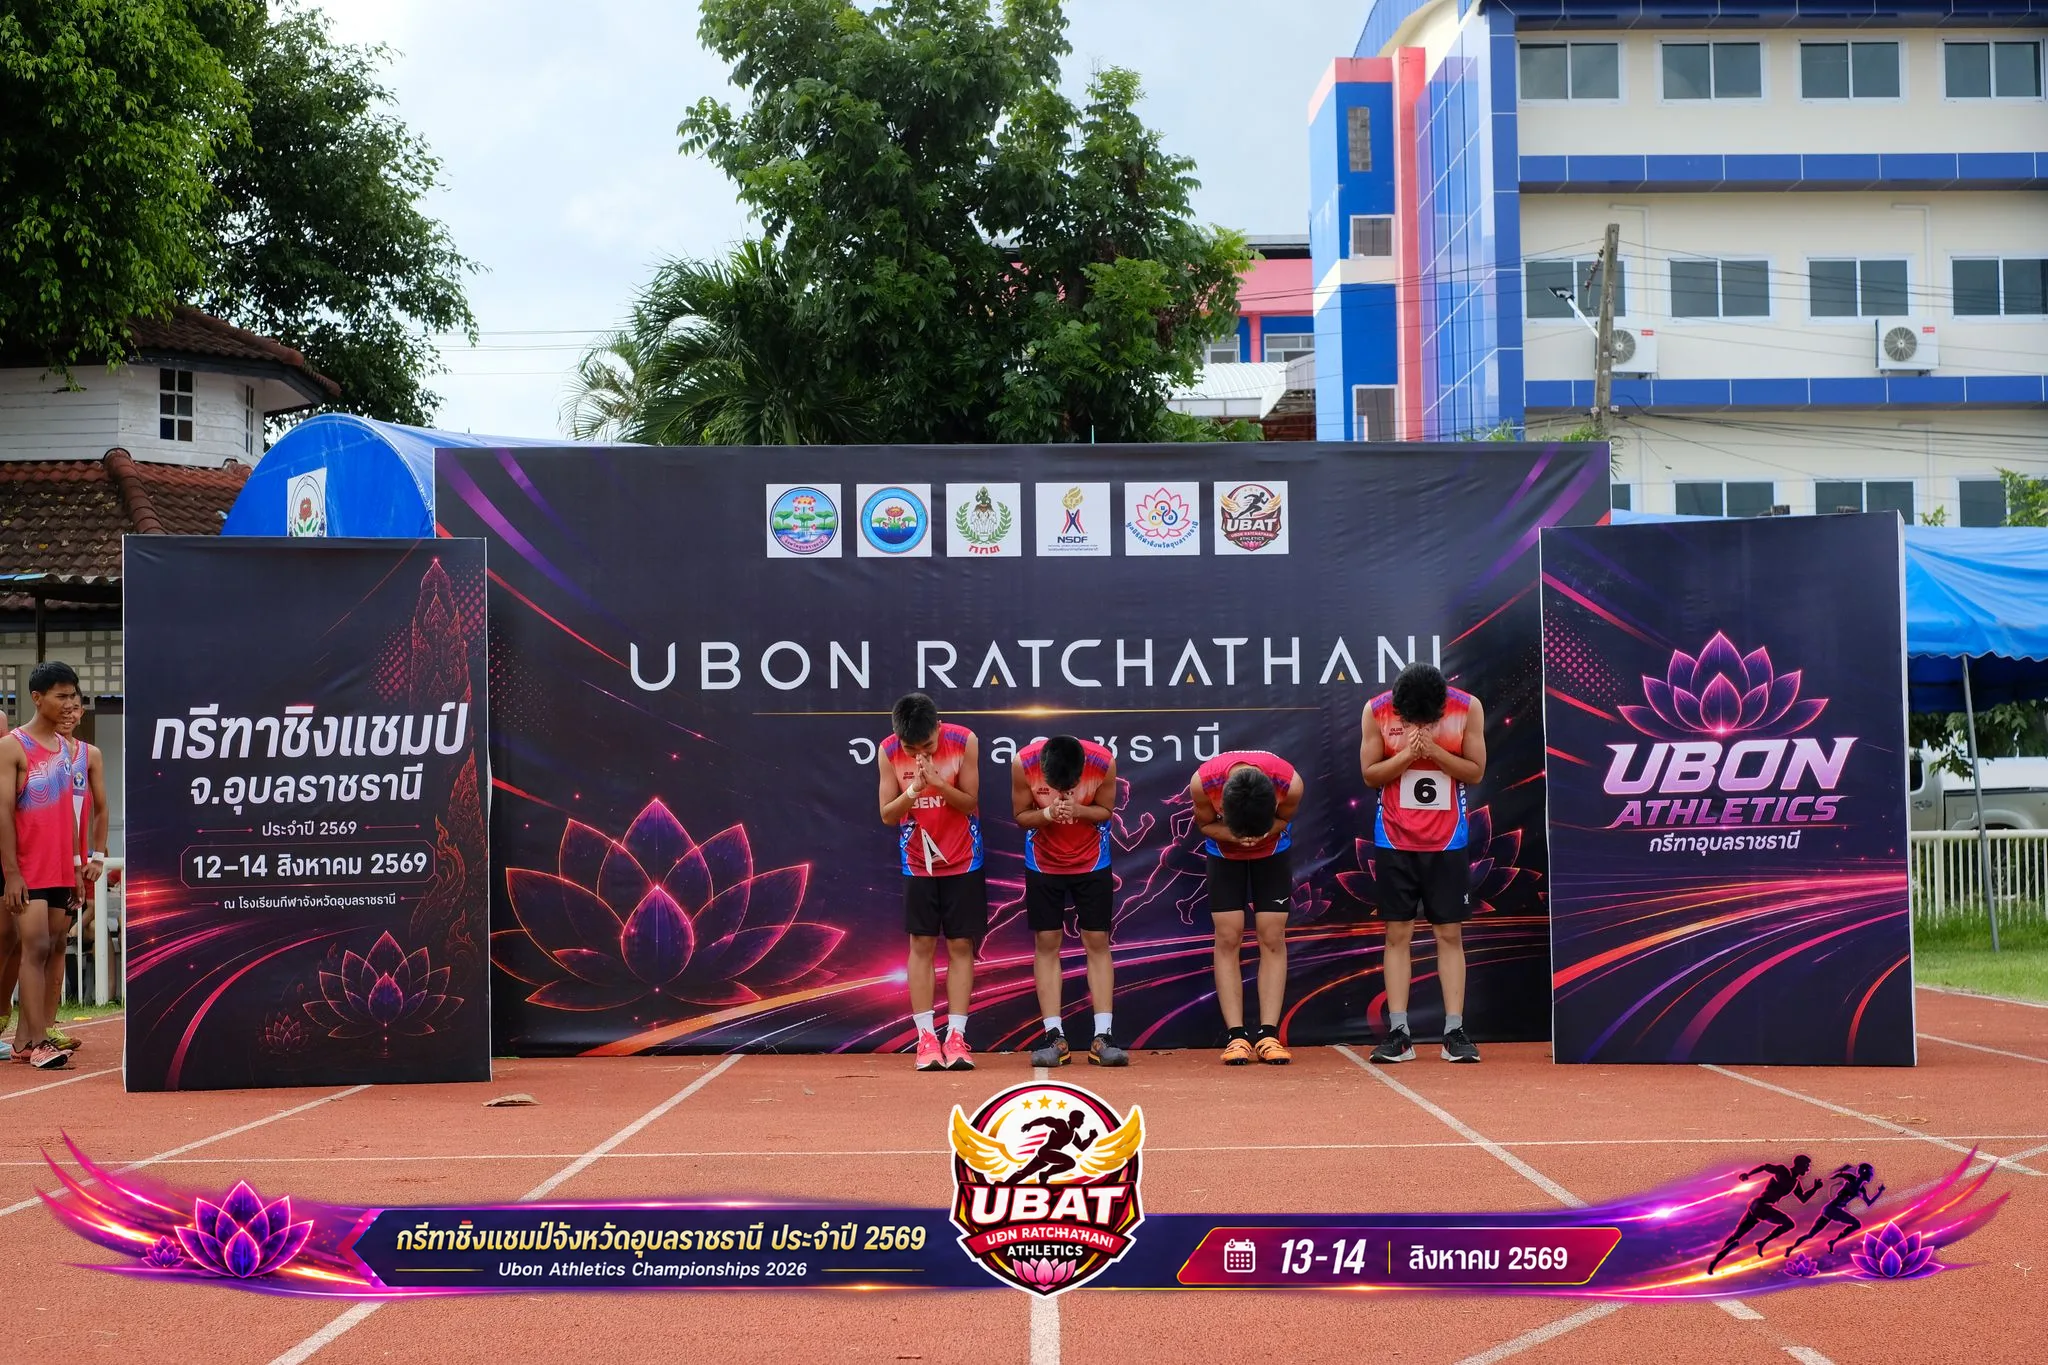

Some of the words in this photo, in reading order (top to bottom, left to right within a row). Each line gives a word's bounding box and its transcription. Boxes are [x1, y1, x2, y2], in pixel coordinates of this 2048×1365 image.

[1226, 518, 1278, 531] UBAT
[968, 545, 1000, 555] กกท
[1057, 536, 1088, 544] NSDF
[630, 640, 870, 692] UBON
[917, 634, 1441, 690] RATCHATHANI
[151, 701, 470, 760] กรีฑาชิงแชมป์
[1603, 737, 1859, 796] UBON
[190, 763, 424, 816] จ.อุบลราชธานี
[1413, 777, 1437, 804] 6
[1604, 795, 1852, 829] ATHLETICS
[262, 819, 315, 838] ประจำปี
[319, 821, 358, 836] 2569
[1649, 829, 1802, 857] กรีฑาอุบลราชธานี
[277, 853, 362, 877] สิงหาคม
[370, 852, 428, 875] 2569
[223, 899, 236, 910] ณ
[239, 892, 397, 910] โรงเรียนกีฬาจังหวัดอุบลราชธานี
